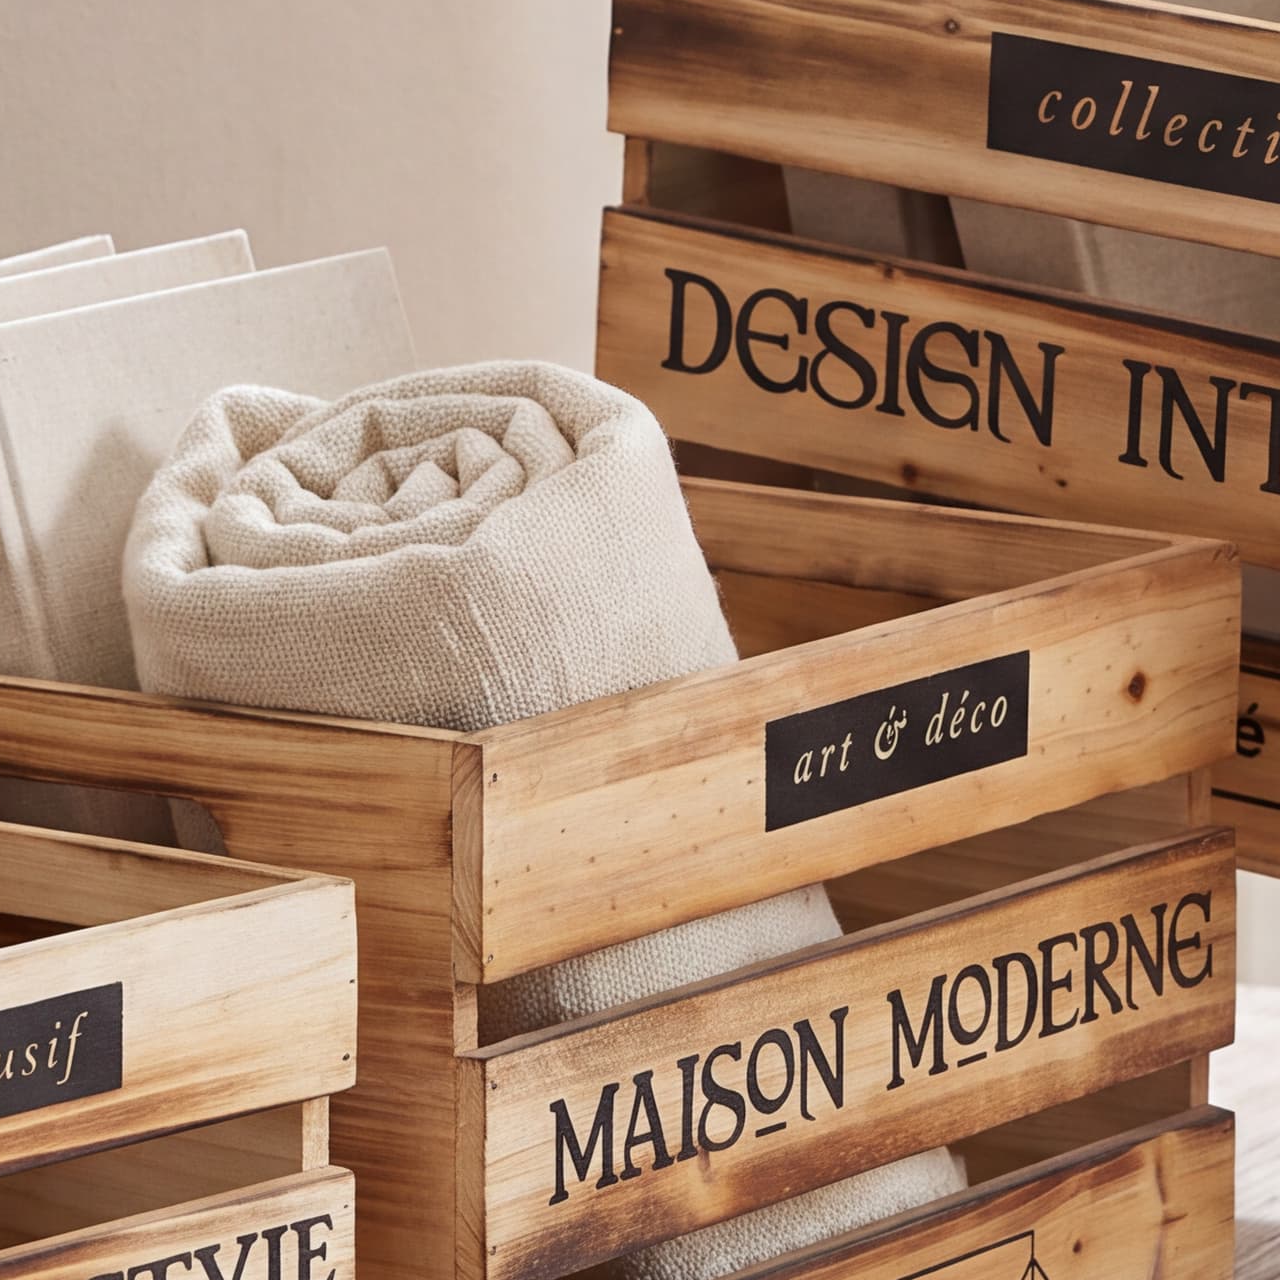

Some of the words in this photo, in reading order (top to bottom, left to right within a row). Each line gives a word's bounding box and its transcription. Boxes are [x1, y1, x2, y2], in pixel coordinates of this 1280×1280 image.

[662, 267, 1066, 446] DESIGN
[793, 732, 852, 785] art
[874, 705, 907, 760] &
[925, 690, 1008, 746] déco
[548, 1005, 850, 1206] MAISON
[886, 891, 1213, 1090] MODERNE
